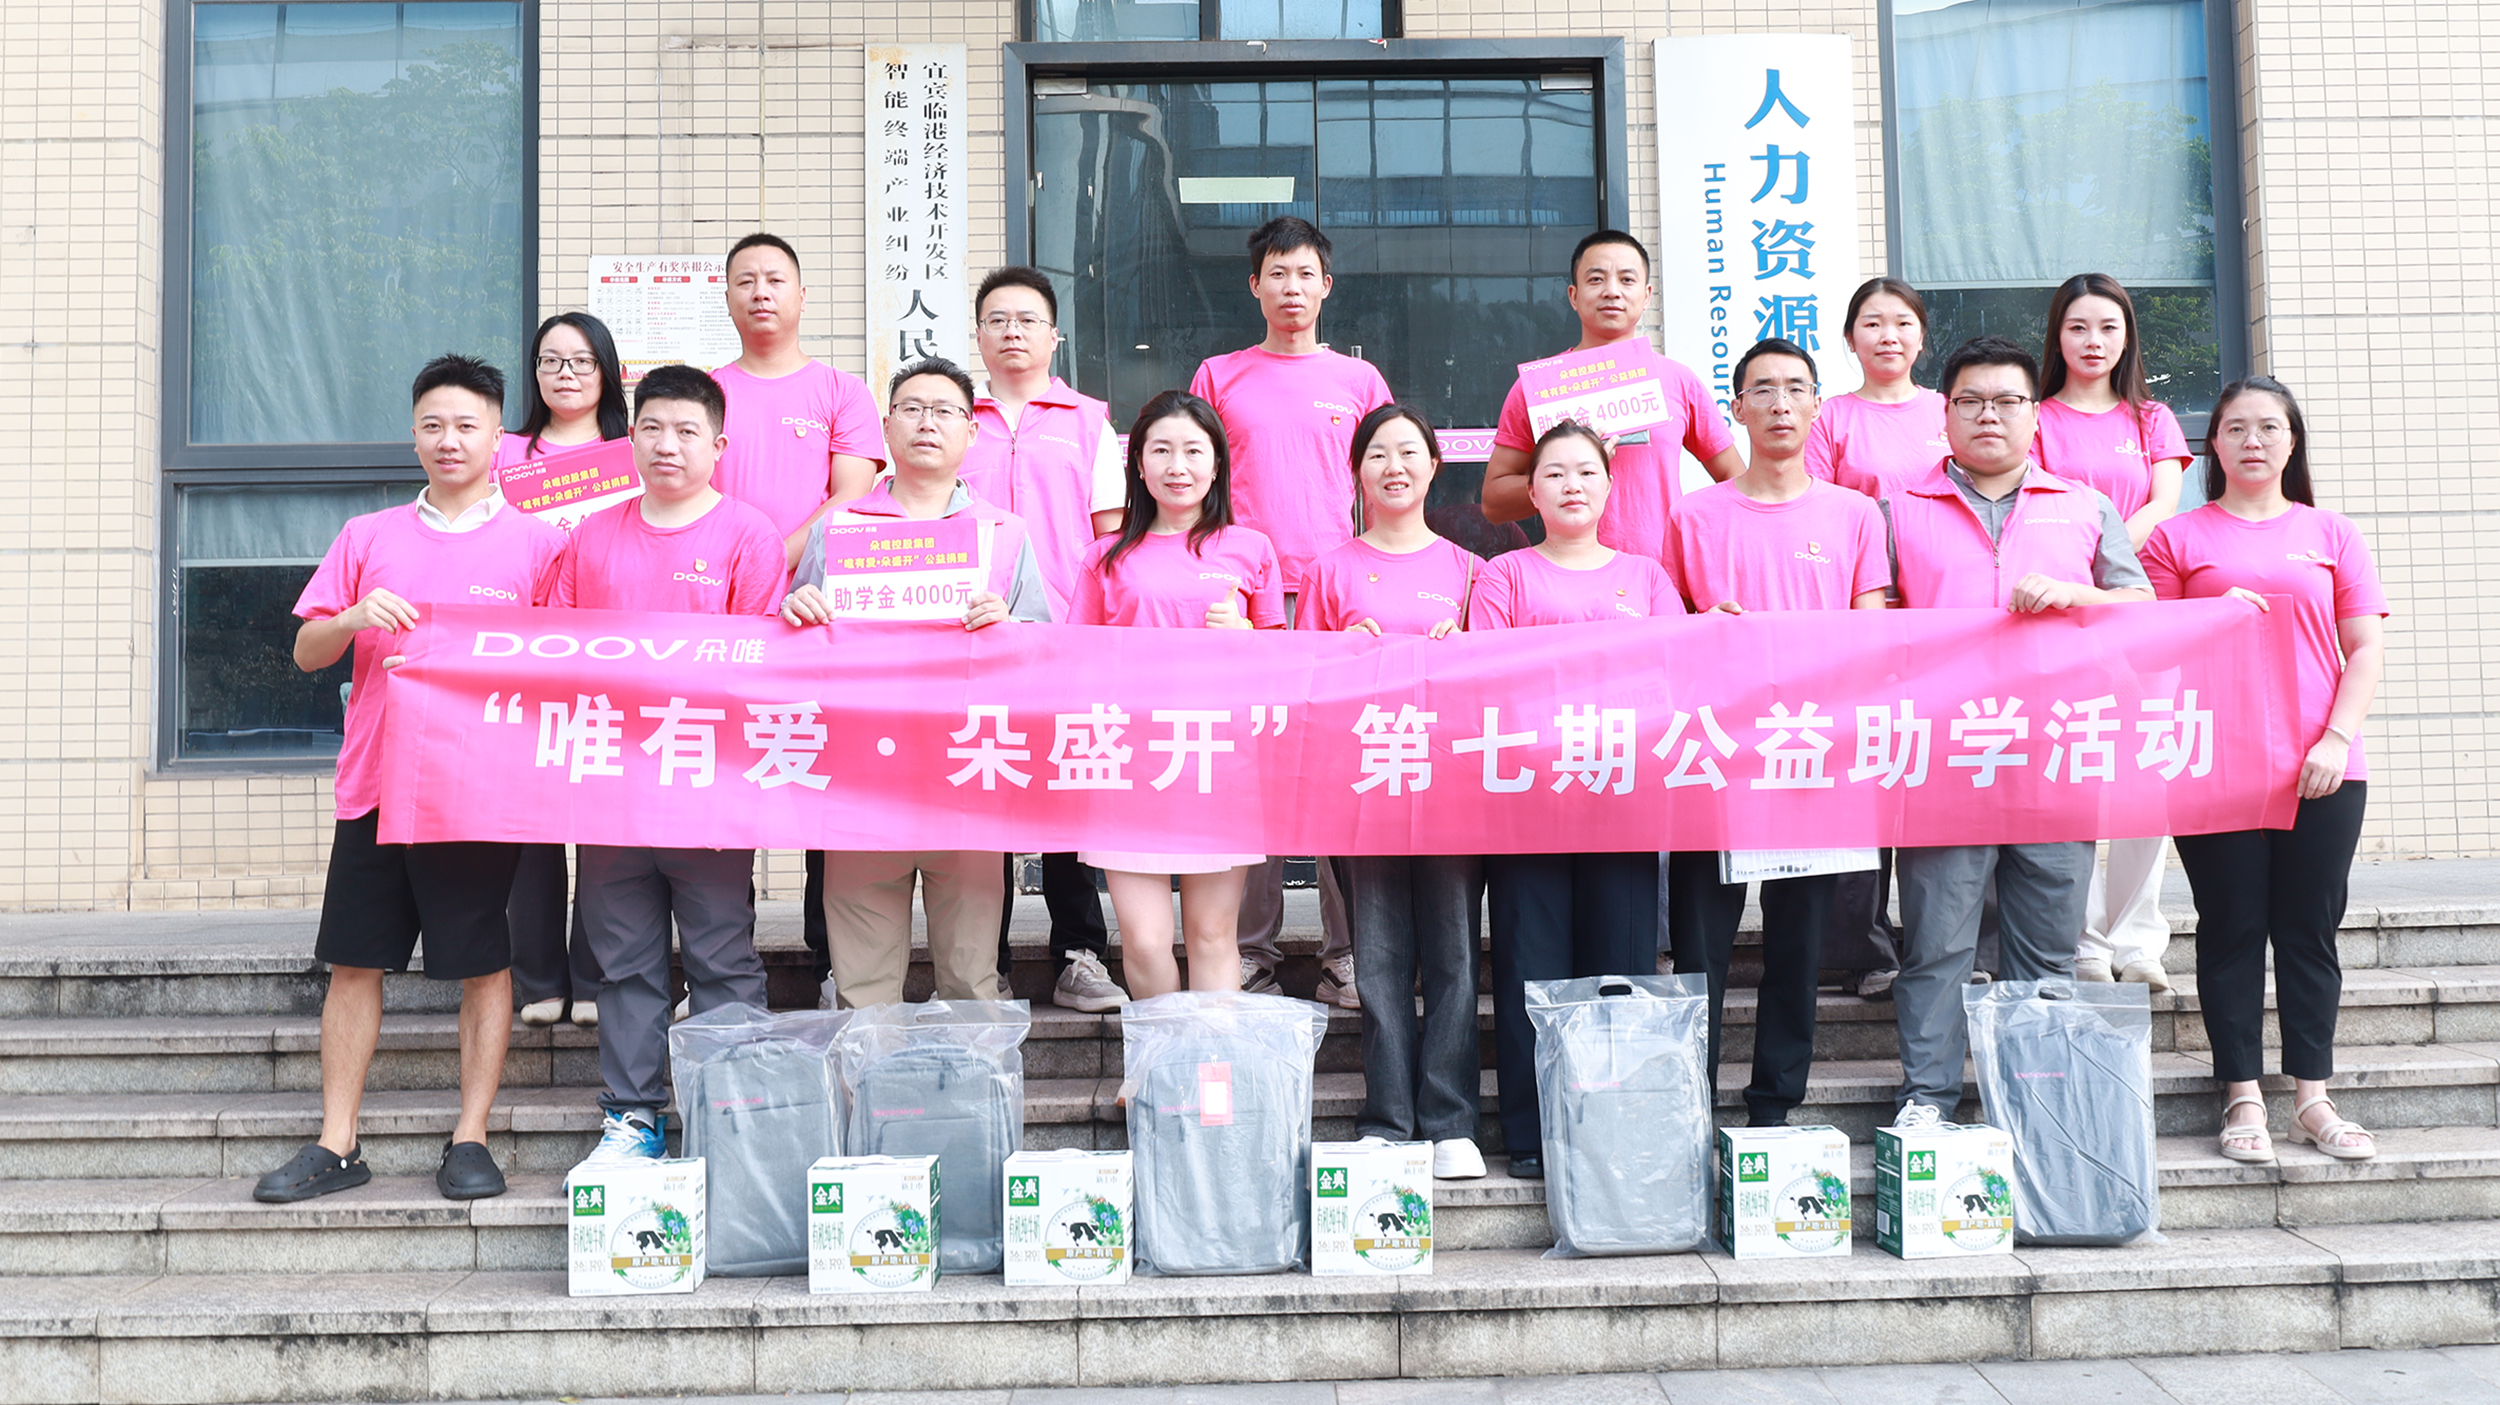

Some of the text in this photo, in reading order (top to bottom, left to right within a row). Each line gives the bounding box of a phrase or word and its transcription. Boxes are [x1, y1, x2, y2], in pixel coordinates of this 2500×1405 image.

[884, 63, 909, 281] 智能终端产业纠纷
[923, 62, 949, 280] 宜宾临港经济技术开发区
[1703, 163, 1726, 274] Human
[1522, 361, 1552, 372] DOOV
[1314, 400, 1354, 415] DOOV
[1597, 391, 1659, 421] 4000元
[781, 417, 830, 431] DOOV
[1436, 439, 1494, 452] OOV
[829, 527, 865, 535] DOOV
[870, 537, 935, 551] 朵唯控股集团
[1794, 551, 1831, 564] DOOV
[673, 572, 723, 586] DOOV
[469, 585, 518, 601] DOOV
[834, 581, 973, 612] 助学金 4000元
[1417, 591, 1461, 612] DOOV
[471, 631, 767, 664] DOOV 朵唯
[1351, 689, 2213, 796] 第七期公益助学活动
[1740, 1154, 1767, 1175] 金典
[1909, 1152, 1934, 1173] 金典
[1011, 1179, 1037, 1199] 金典
[1319, 1170, 1345, 1190] 金典
[575, 1187, 603, 1208] 金典
[814, 1185, 841, 1206] 金典
